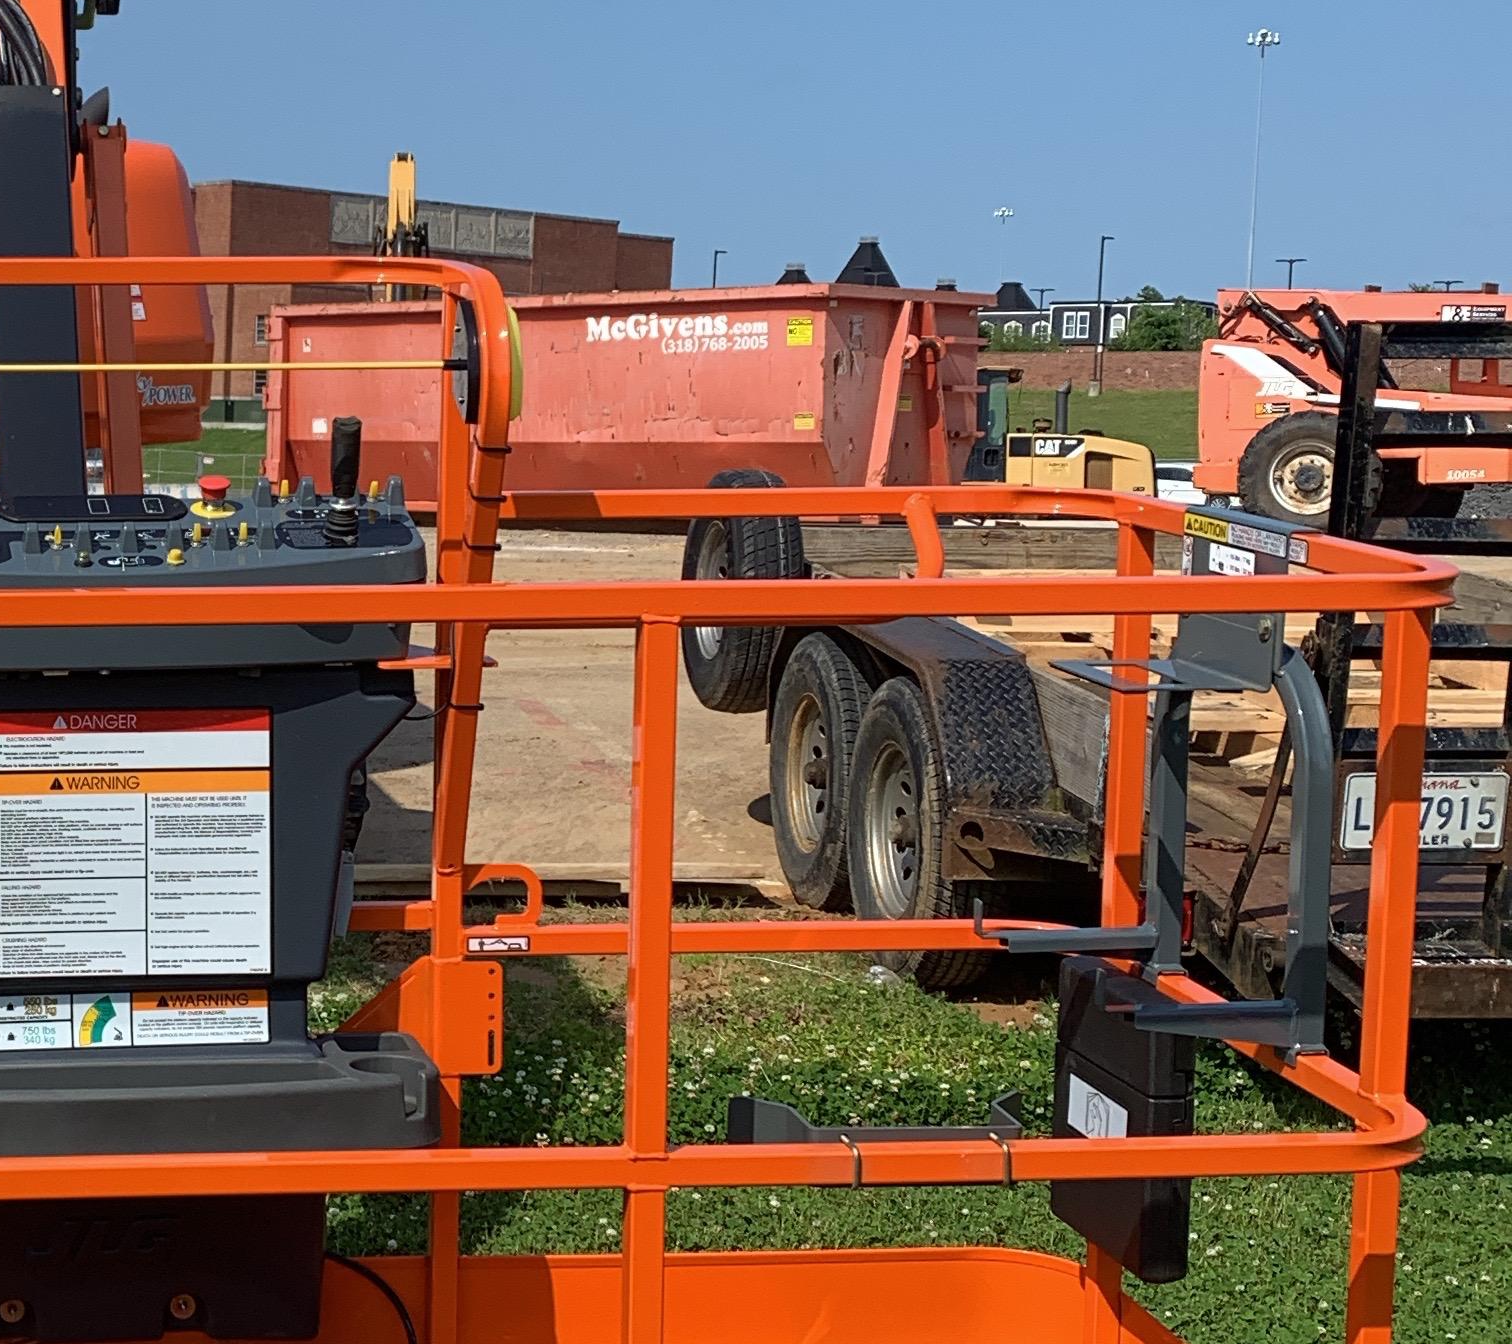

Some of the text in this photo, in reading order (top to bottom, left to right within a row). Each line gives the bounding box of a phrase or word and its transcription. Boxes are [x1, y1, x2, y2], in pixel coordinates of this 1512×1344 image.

[585, 312, 769, 343] McGivens.com
[661, 335, 769, 354] (318) 768-2005
[1035, 439, 1062, 456] CAT
[1192, 518, 1227, 539] CAUTION
[70, 714, 137, 729] DANGER
[66, 775, 140, 791] WARNING
[169, 992, 249, 1008] WARNING
[45, 1005, 57, 1016] kg
[22, 1026, 56, 1036] 750 lbs
[24, 1035, 55, 1046] 340 kg
